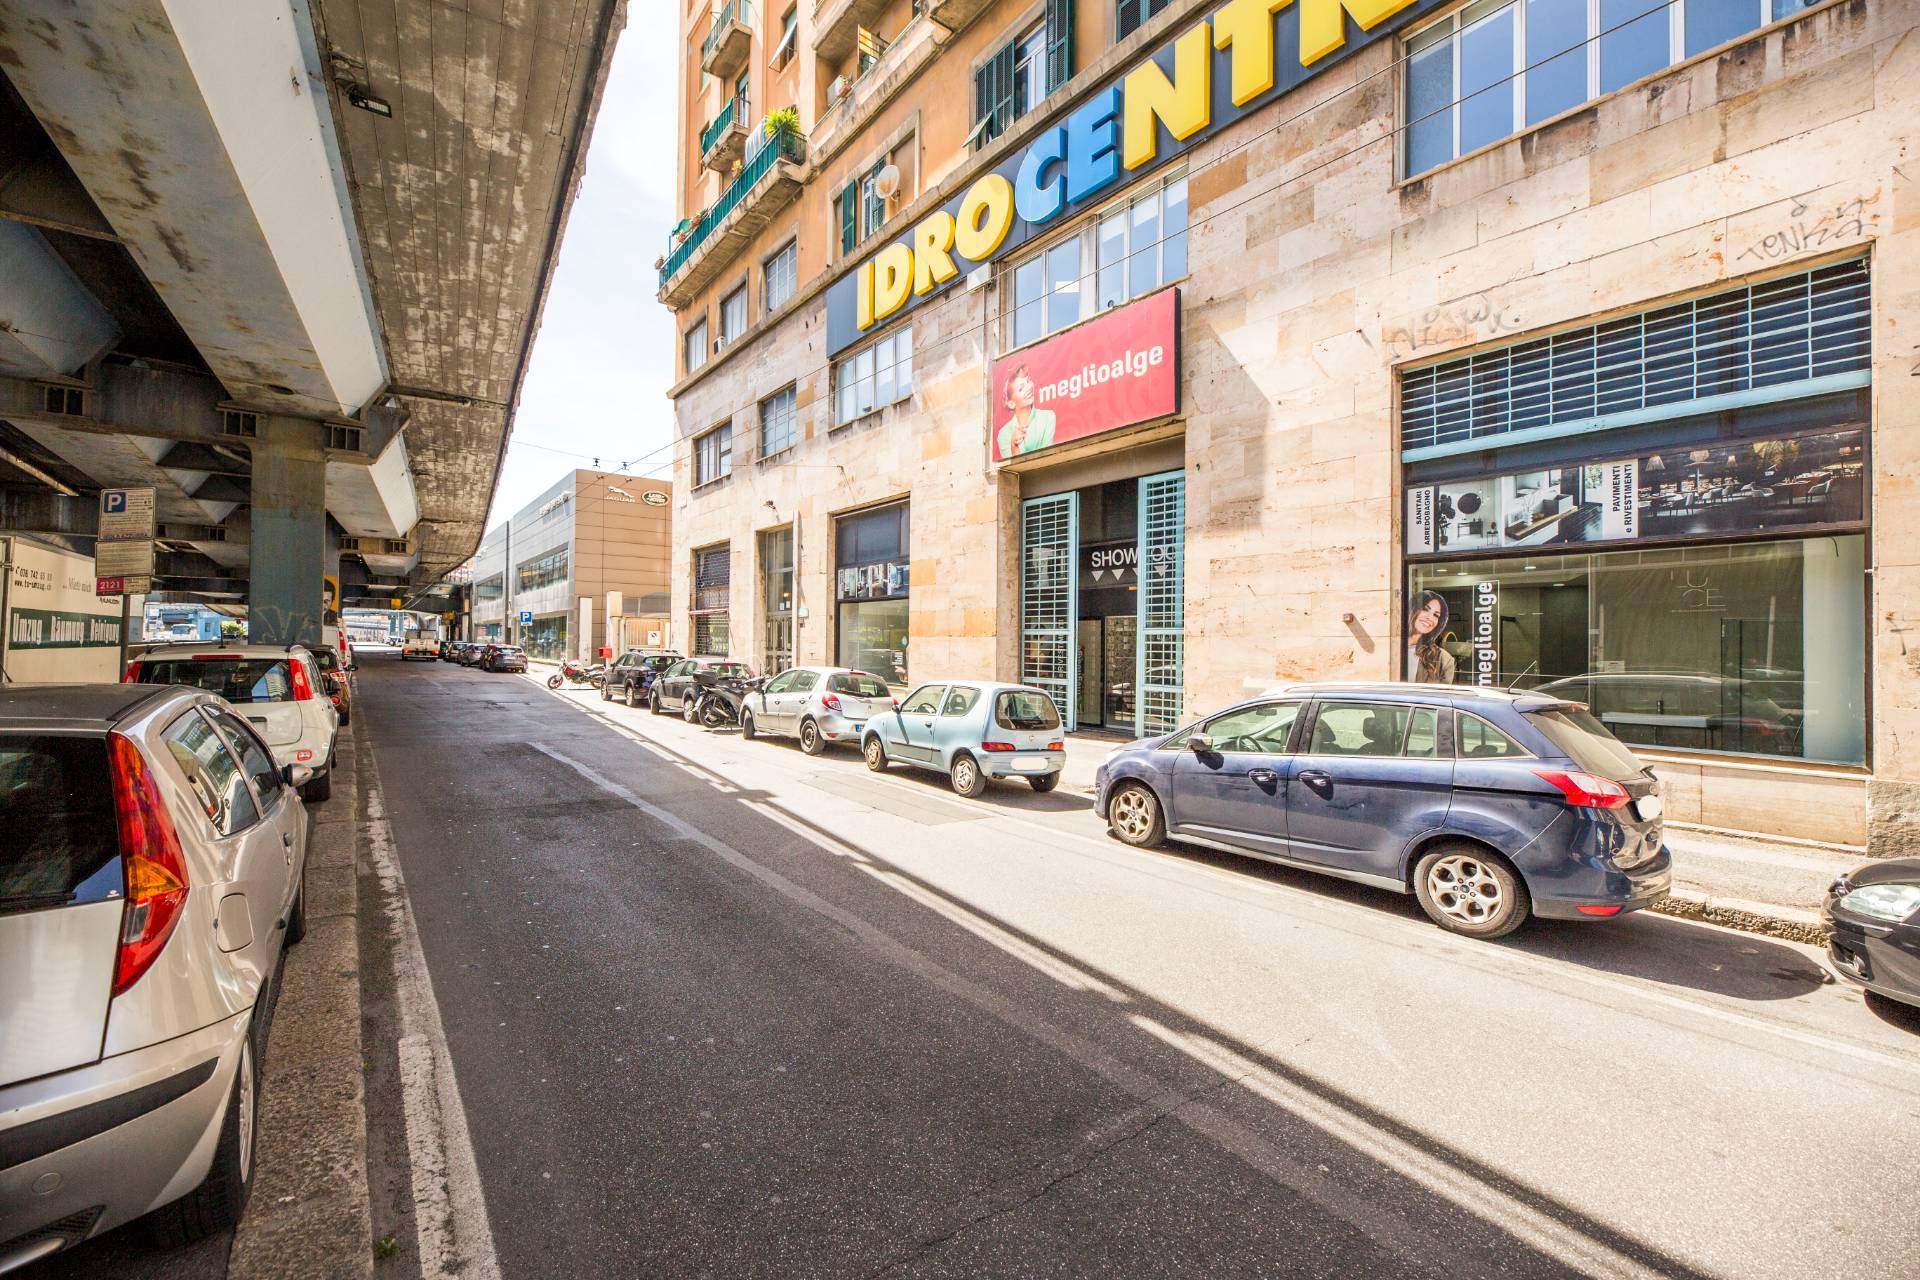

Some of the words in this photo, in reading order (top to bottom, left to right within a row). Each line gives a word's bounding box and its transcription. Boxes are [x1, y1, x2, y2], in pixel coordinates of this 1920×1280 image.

[1038, 345, 1164, 404] meglioalge
[108, 494, 122, 512] P
[604, 494, 636, 503] JAGUAR
[1612, 465, 1621, 512] PAVIMENTI
[1623, 463, 1632, 526] RIVESTIMENTI
[100, 581, 120, 589] 2121
[12, 612, 42, 645] Umzug
[522, 613, 530, 622] P
[1474, 582, 1497, 687] meglioalge
